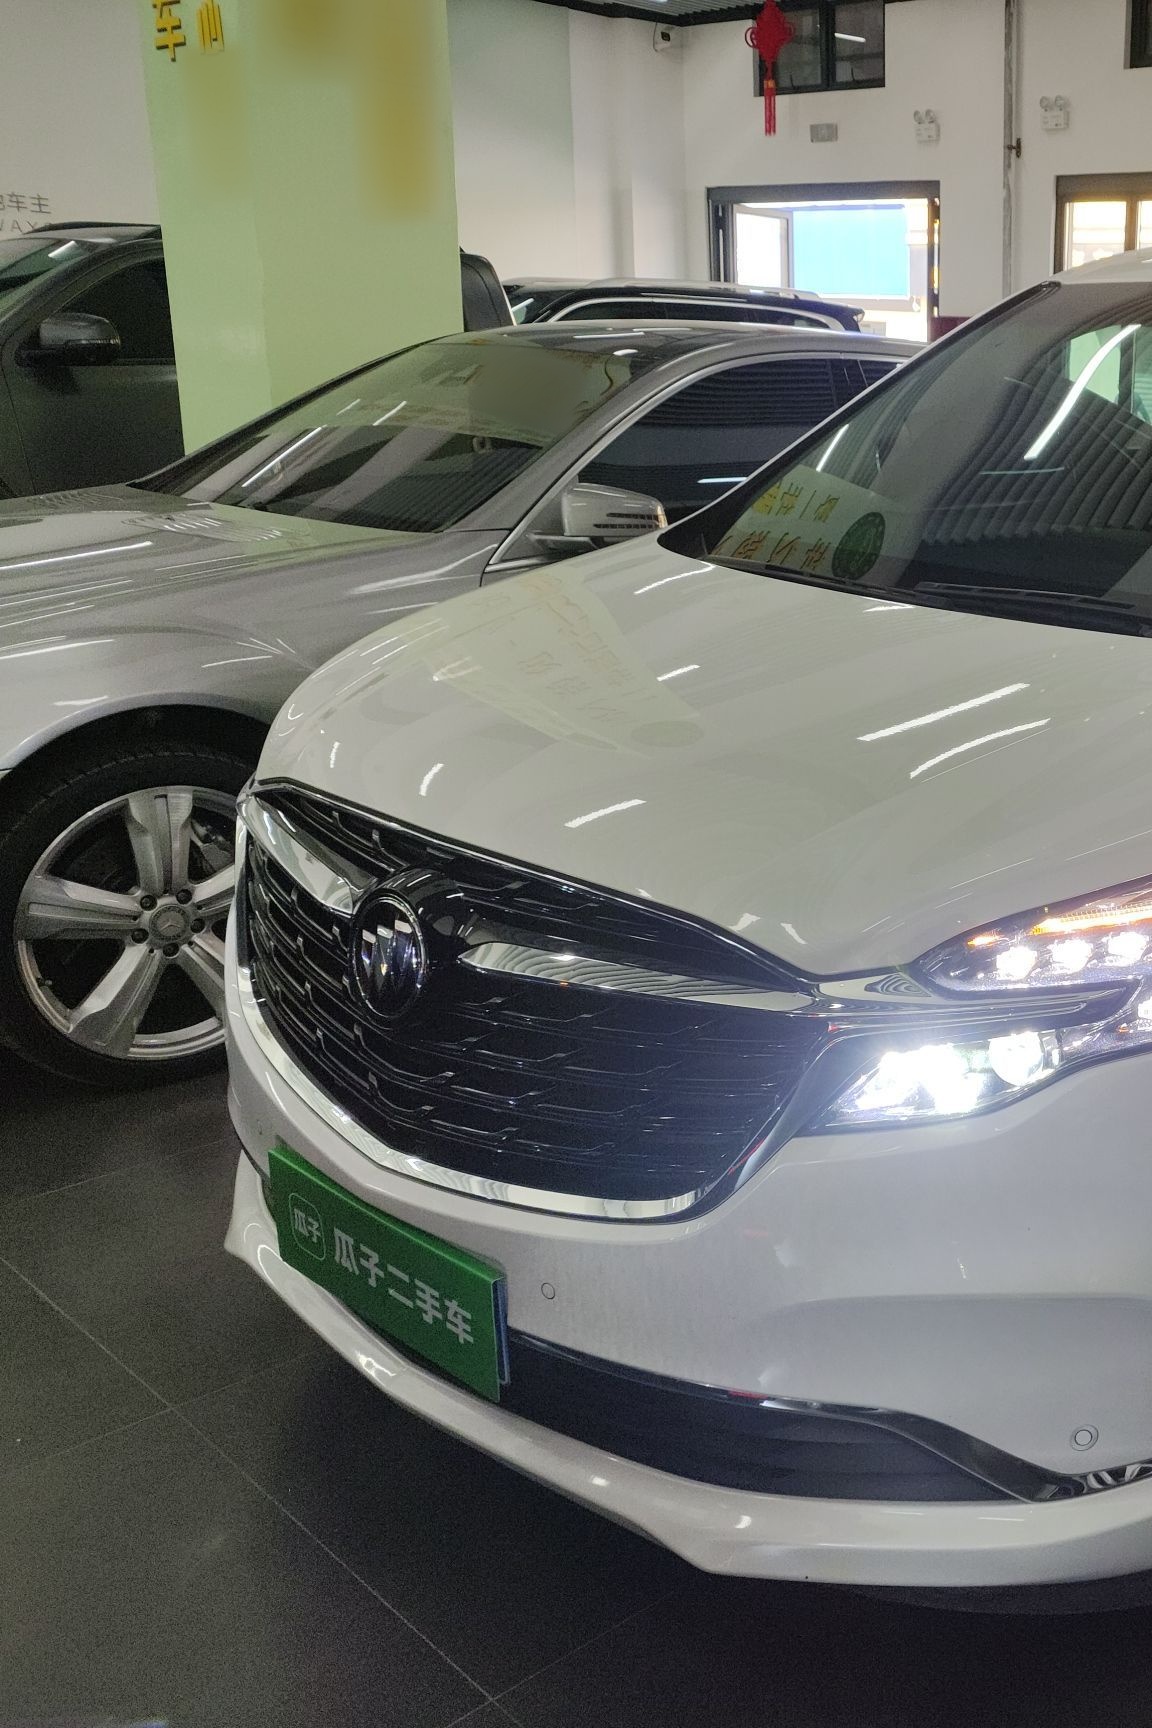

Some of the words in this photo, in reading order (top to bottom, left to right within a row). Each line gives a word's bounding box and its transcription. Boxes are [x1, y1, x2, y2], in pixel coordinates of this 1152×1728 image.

[293, 1208, 321, 1243] 瓜子
[333, 1227, 474, 1344] 瓜子二手车
